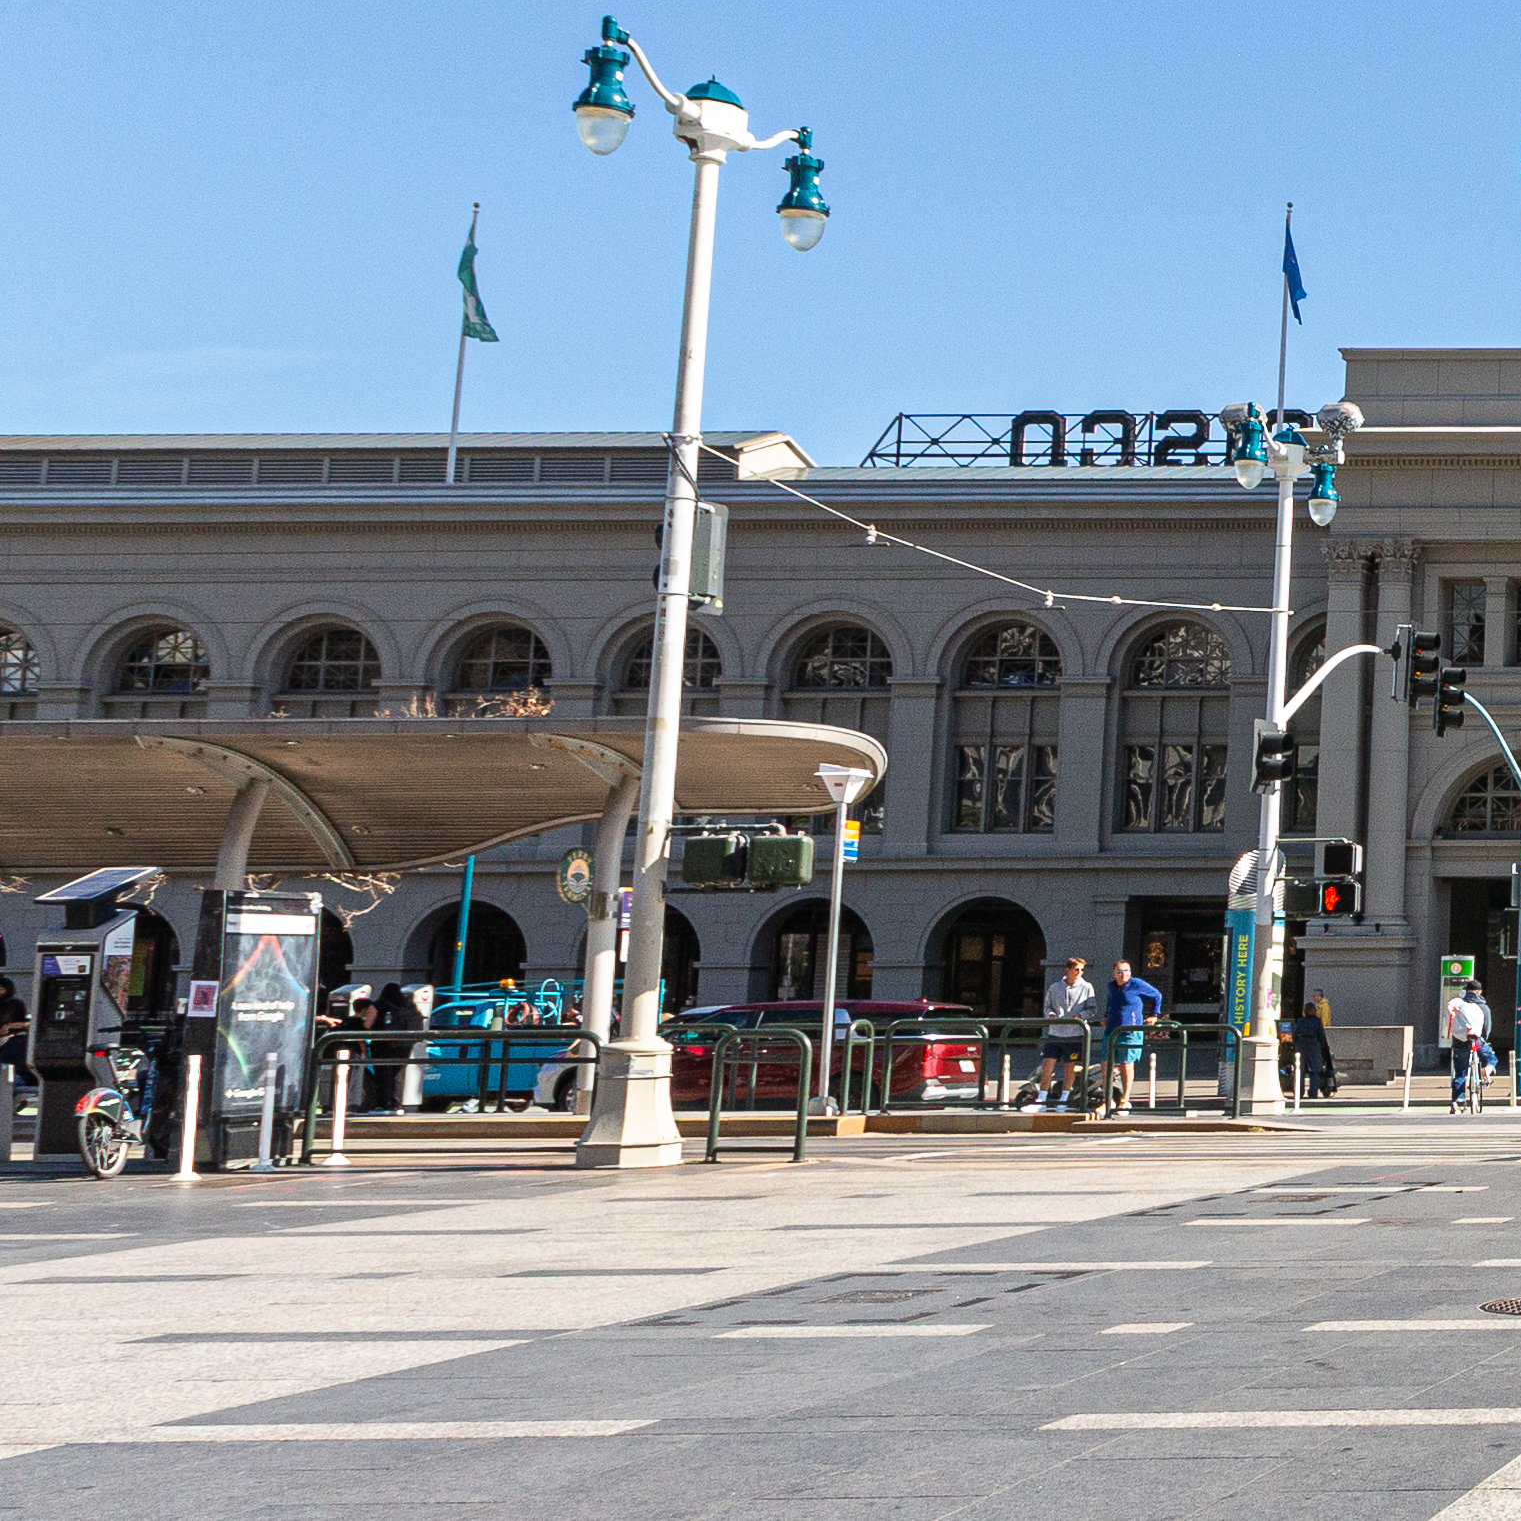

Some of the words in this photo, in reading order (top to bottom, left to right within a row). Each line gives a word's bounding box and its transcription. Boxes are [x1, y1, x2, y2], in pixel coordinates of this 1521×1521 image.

[1237, 934, 1249, 968] HERE
[1234, 971, 1246, 1025] HISTORY
[256, 1010, 286, 1022] Google
